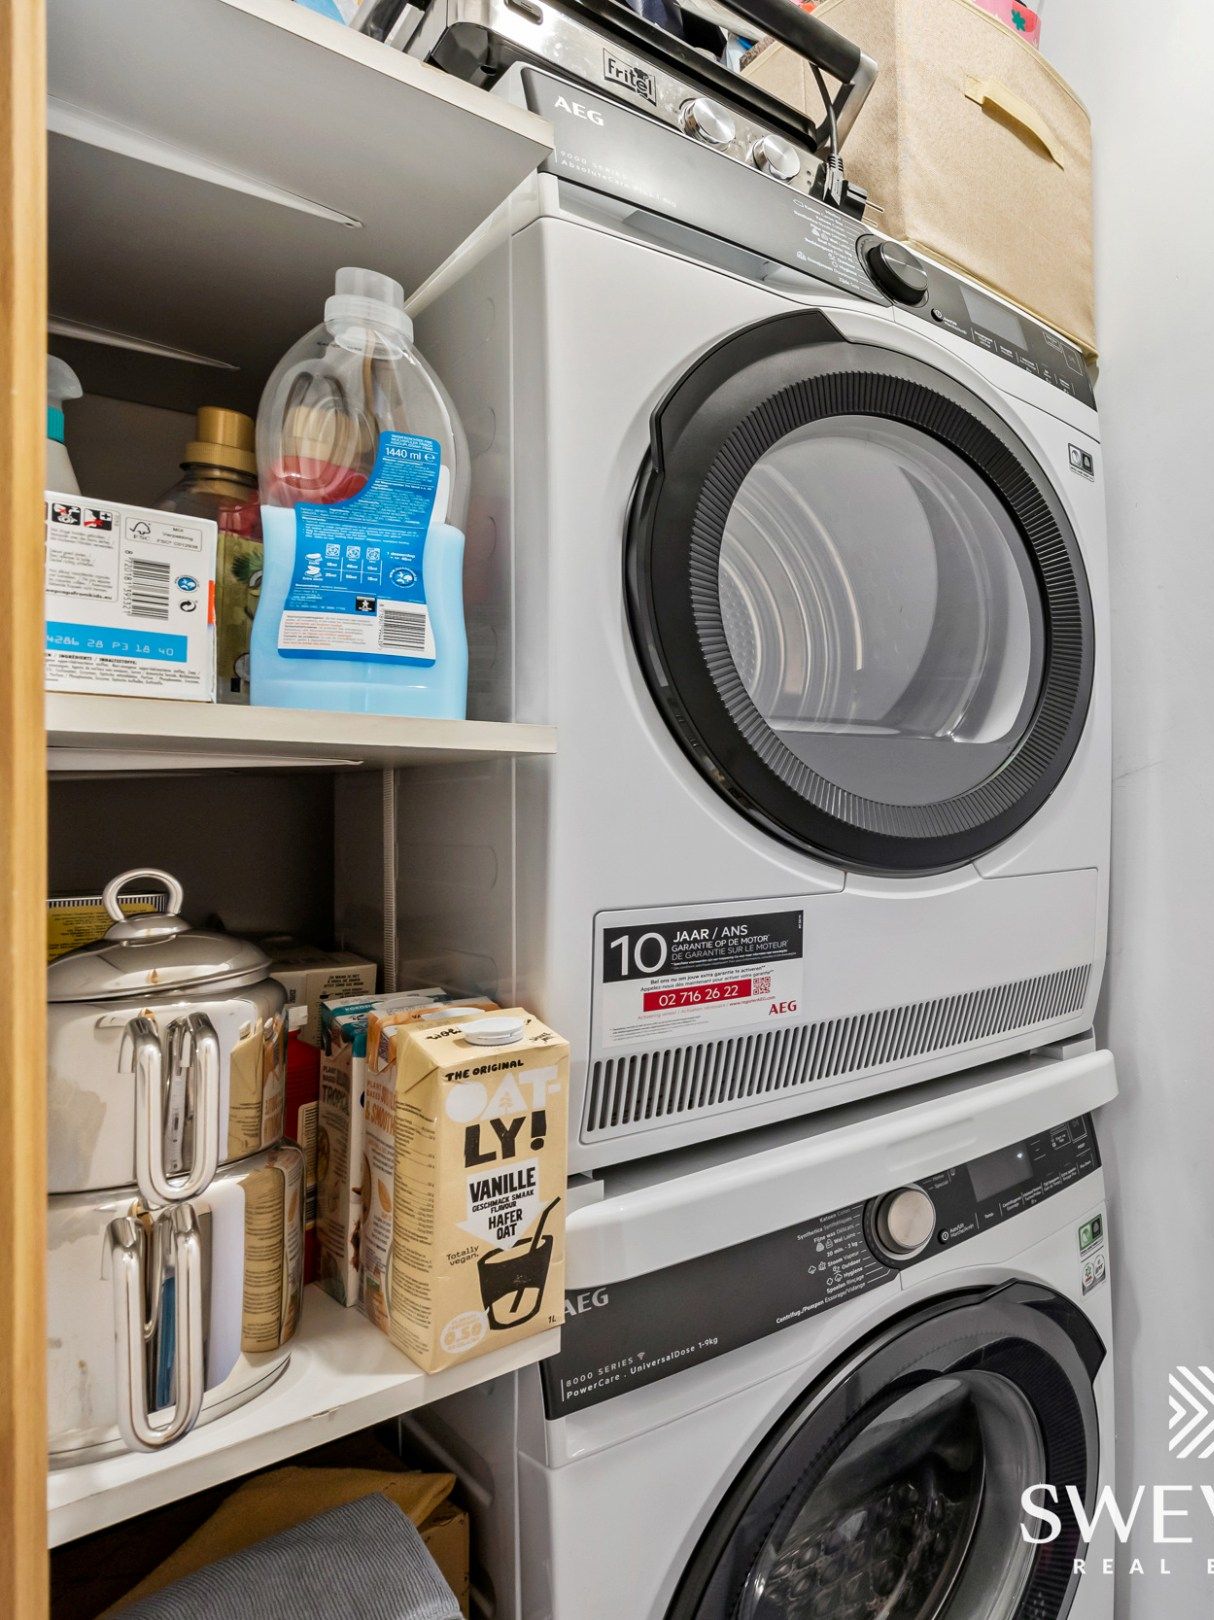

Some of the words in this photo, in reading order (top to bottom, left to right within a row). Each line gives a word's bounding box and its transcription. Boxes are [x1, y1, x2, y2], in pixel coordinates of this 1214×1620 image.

[608, 57, 654, 96] Fritel
[554, 95, 604, 126] AEG
[385, 447, 408, 458] 1440
[112, 642, 129, 650] P3
[673, 928, 709, 942] JAAR
[712, 927, 718, 940] /
[721, 925, 748, 937] ANS
[610, 932, 668, 976] 10
[671, 941, 713, 952] GARANTIE
[685, 948, 725, 959] GARANTIE
[728, 946, 743, 954] SUR
[659, 994, 676, 1006] 02
[680, 991, 701, 1003] 716
[705, 988, 720, 1000] 26
[724, 985, 738, 997] 22
[768, 1000, 797, 1016] AEG
[445, 1069, 469, 1082] THE
[472, 1059, 524, 1076] ORIGINAL
[464, 1110, 547, 1168] LY!
[469, 1166, 536, 1203] VANILLE
[472, 1195, 509, 1213] GESCHMACK
[512, 1189, 534, 1200] SMAAK
[490, 1201, 517, 1214] FLAVOUR
[488, 1208, 523, 1230] HAFER
[497, 1223, 517, 1240] OAT
[446, 1246, 479, 1261] Totally
[449, 1253, 479, 1266] vegan.
[565, 1287, 609, 1316] AEG
[549, 1315, 556, 1324] 1L
[566, 1374, 620, 1399] PowerCare
[630, 1345, 695, 1375] UniversalDose
[698, 1336, 718, 1349] 1-9kg
[566, 1372, 593, 1388] 8000
[598, 1356, 634, 1376] SERIES
